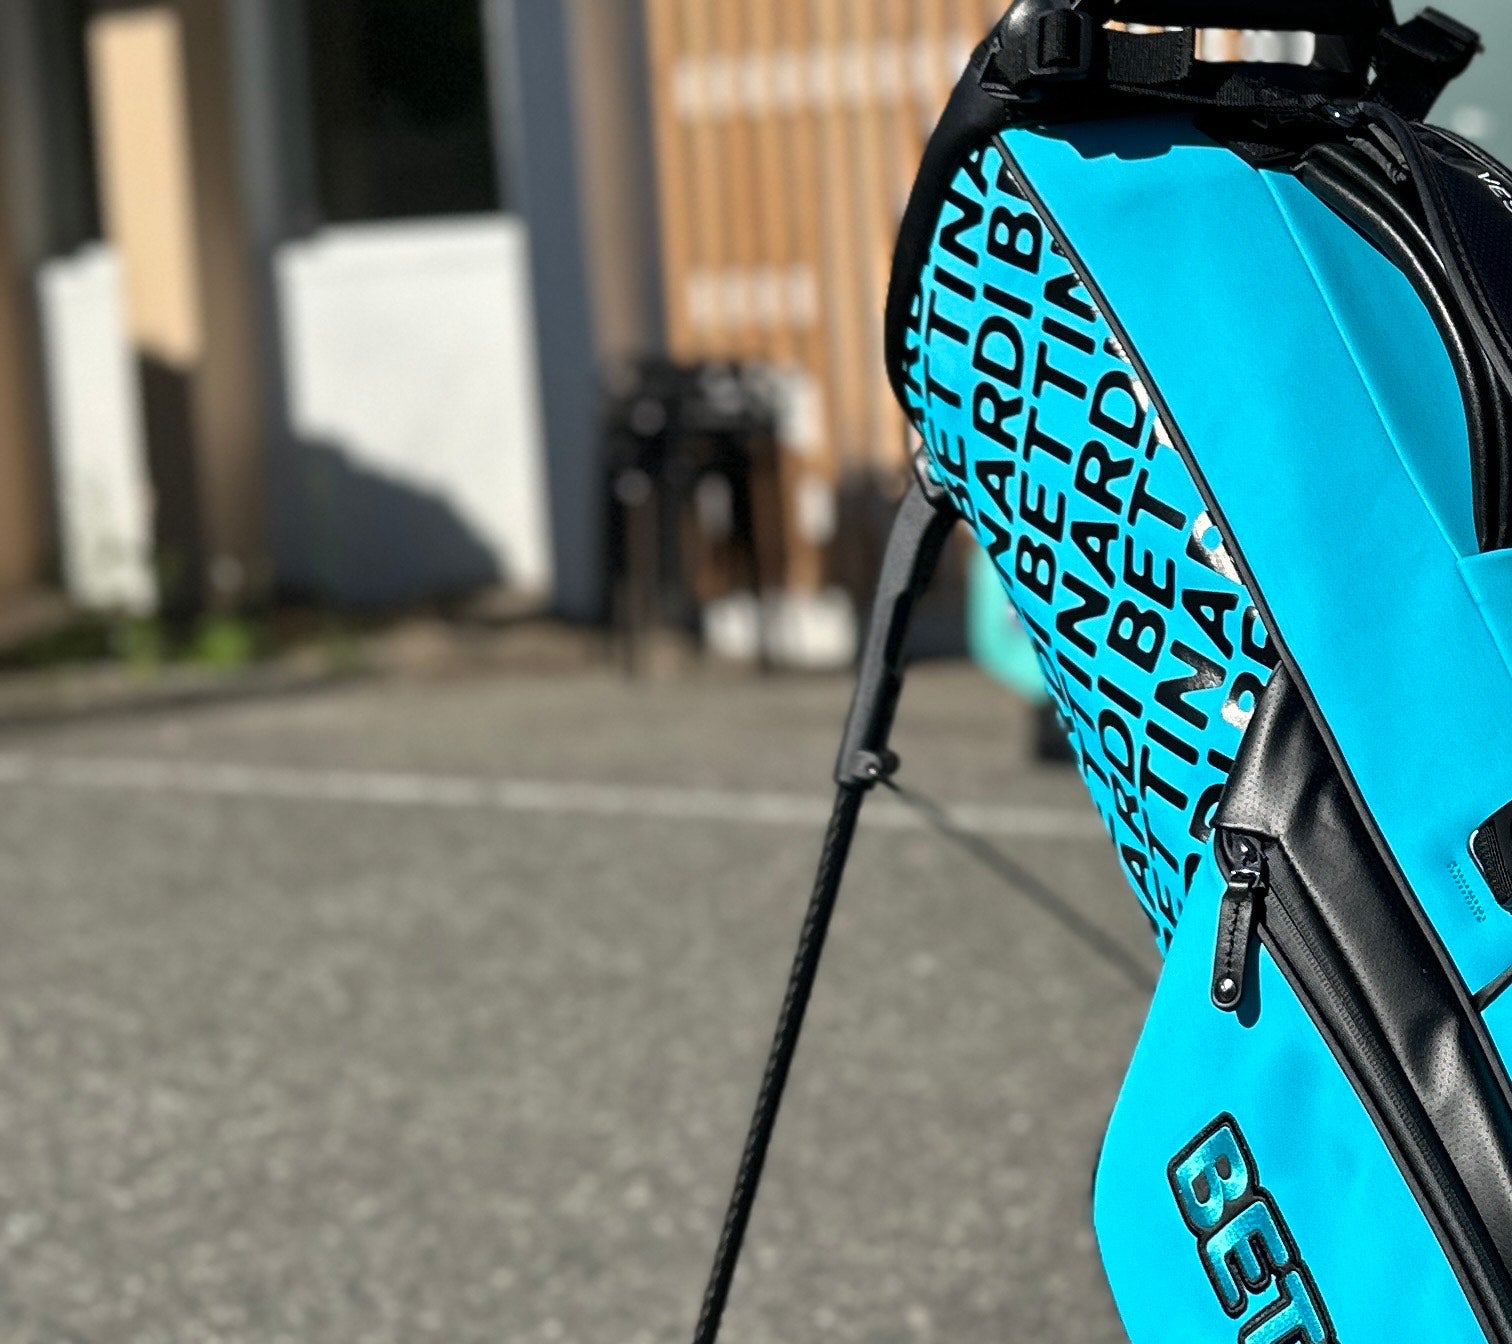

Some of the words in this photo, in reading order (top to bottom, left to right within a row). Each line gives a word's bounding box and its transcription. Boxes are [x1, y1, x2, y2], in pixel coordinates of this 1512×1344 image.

[1066, 335, 1149, 846] TTINARD
[1098, 672, 1162, 939] ARDI
[1140, 510, 1246, 954] ETTINAR
